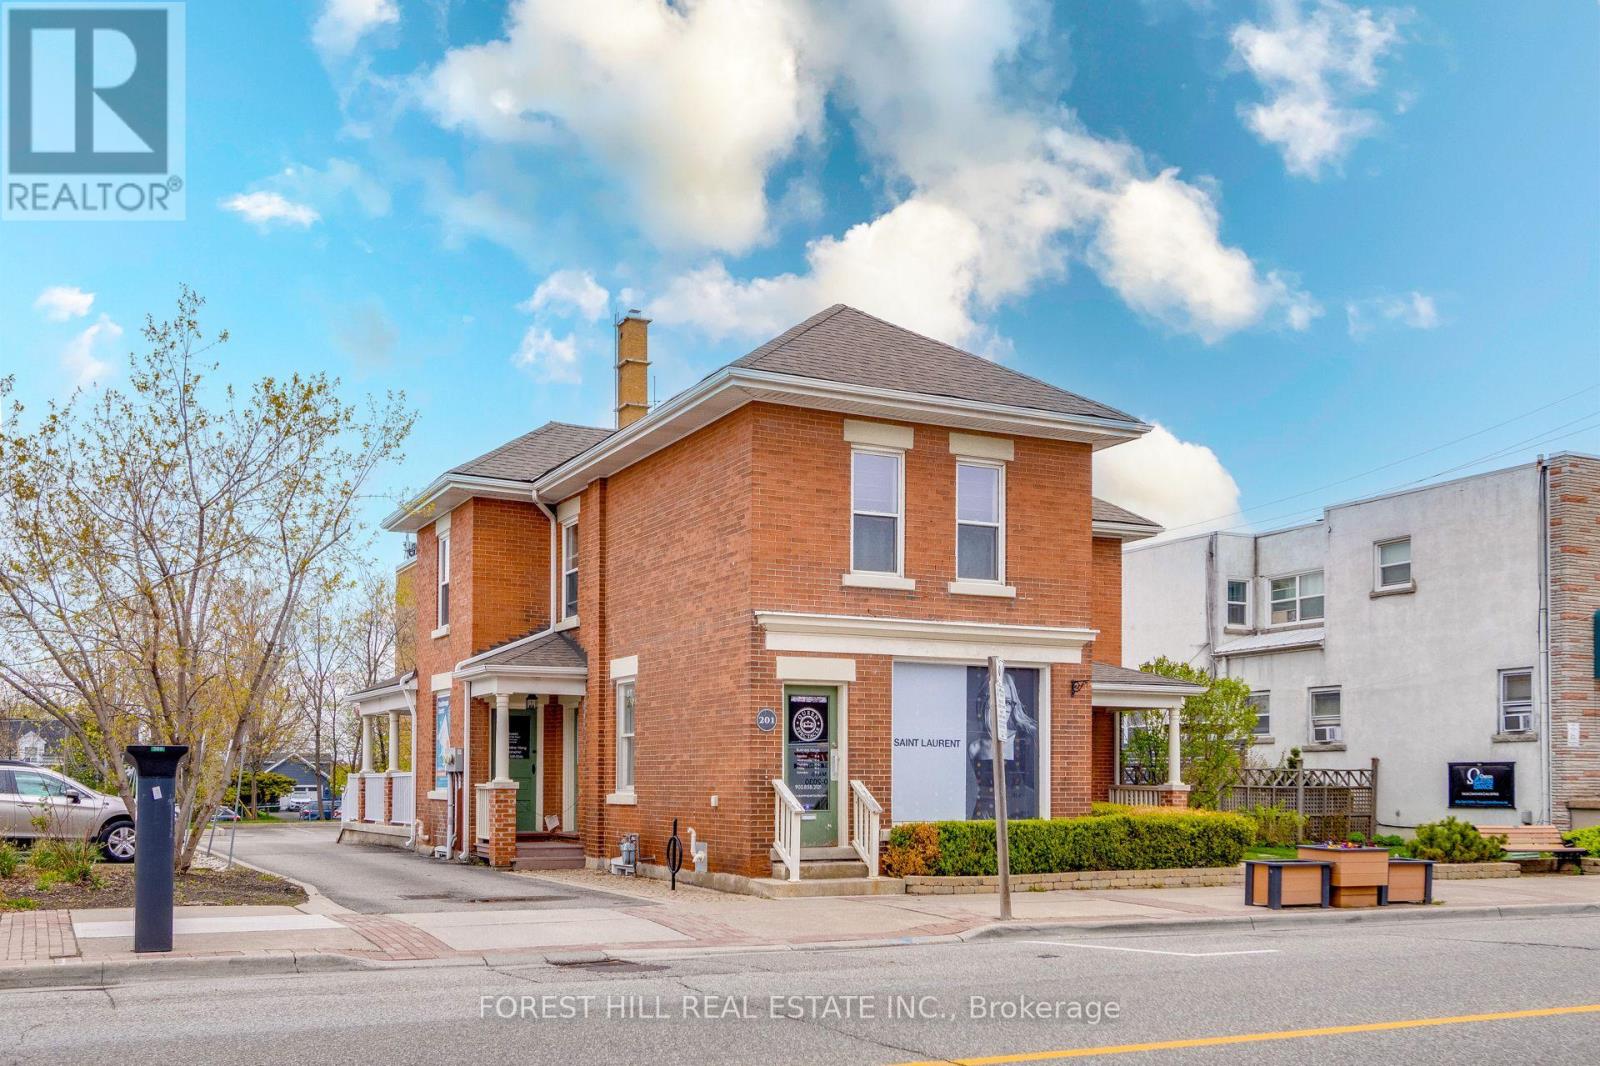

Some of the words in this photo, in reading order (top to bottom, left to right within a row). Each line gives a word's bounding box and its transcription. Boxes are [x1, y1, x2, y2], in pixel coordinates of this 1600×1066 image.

[797, 710, 819, 720] QUEEN
[894, 738, 919, 746] SAINT
[921, 739, 960, 747] LAURENT
